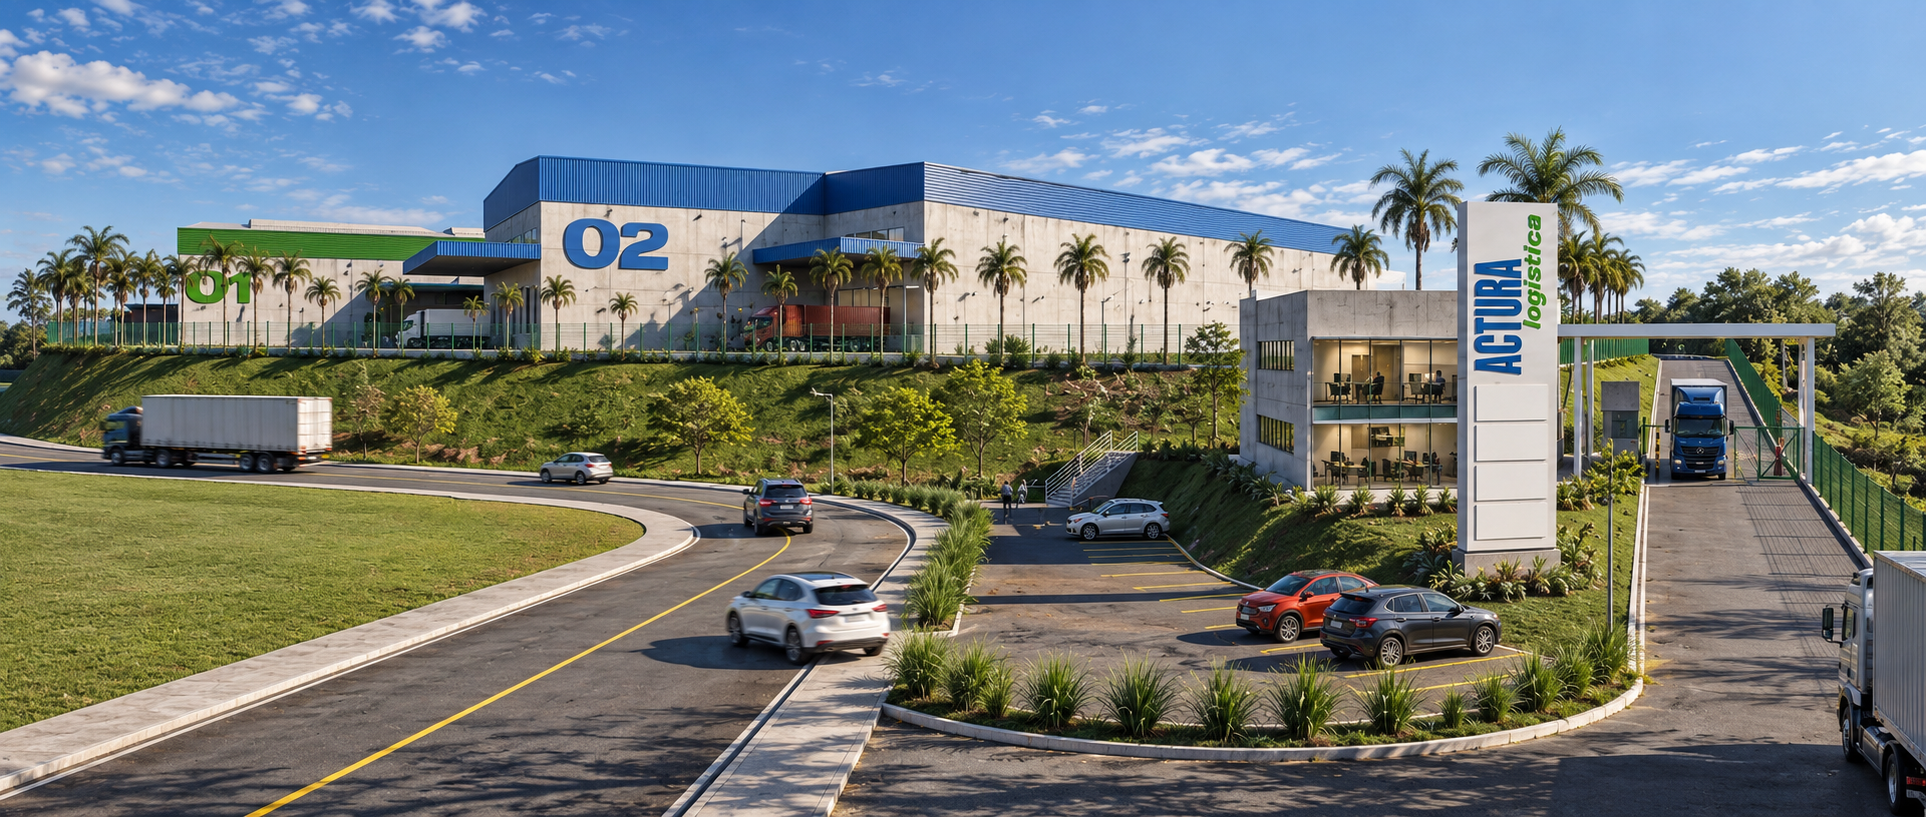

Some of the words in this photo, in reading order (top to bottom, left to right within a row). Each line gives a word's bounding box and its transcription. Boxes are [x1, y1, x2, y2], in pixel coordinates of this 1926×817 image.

[563, 218, 669, 271] 02
[1523, 214, 1546, 330] logistica
[186, 271, 251, 304] 01
[1474, 258, 1522, 376] ACTURA
